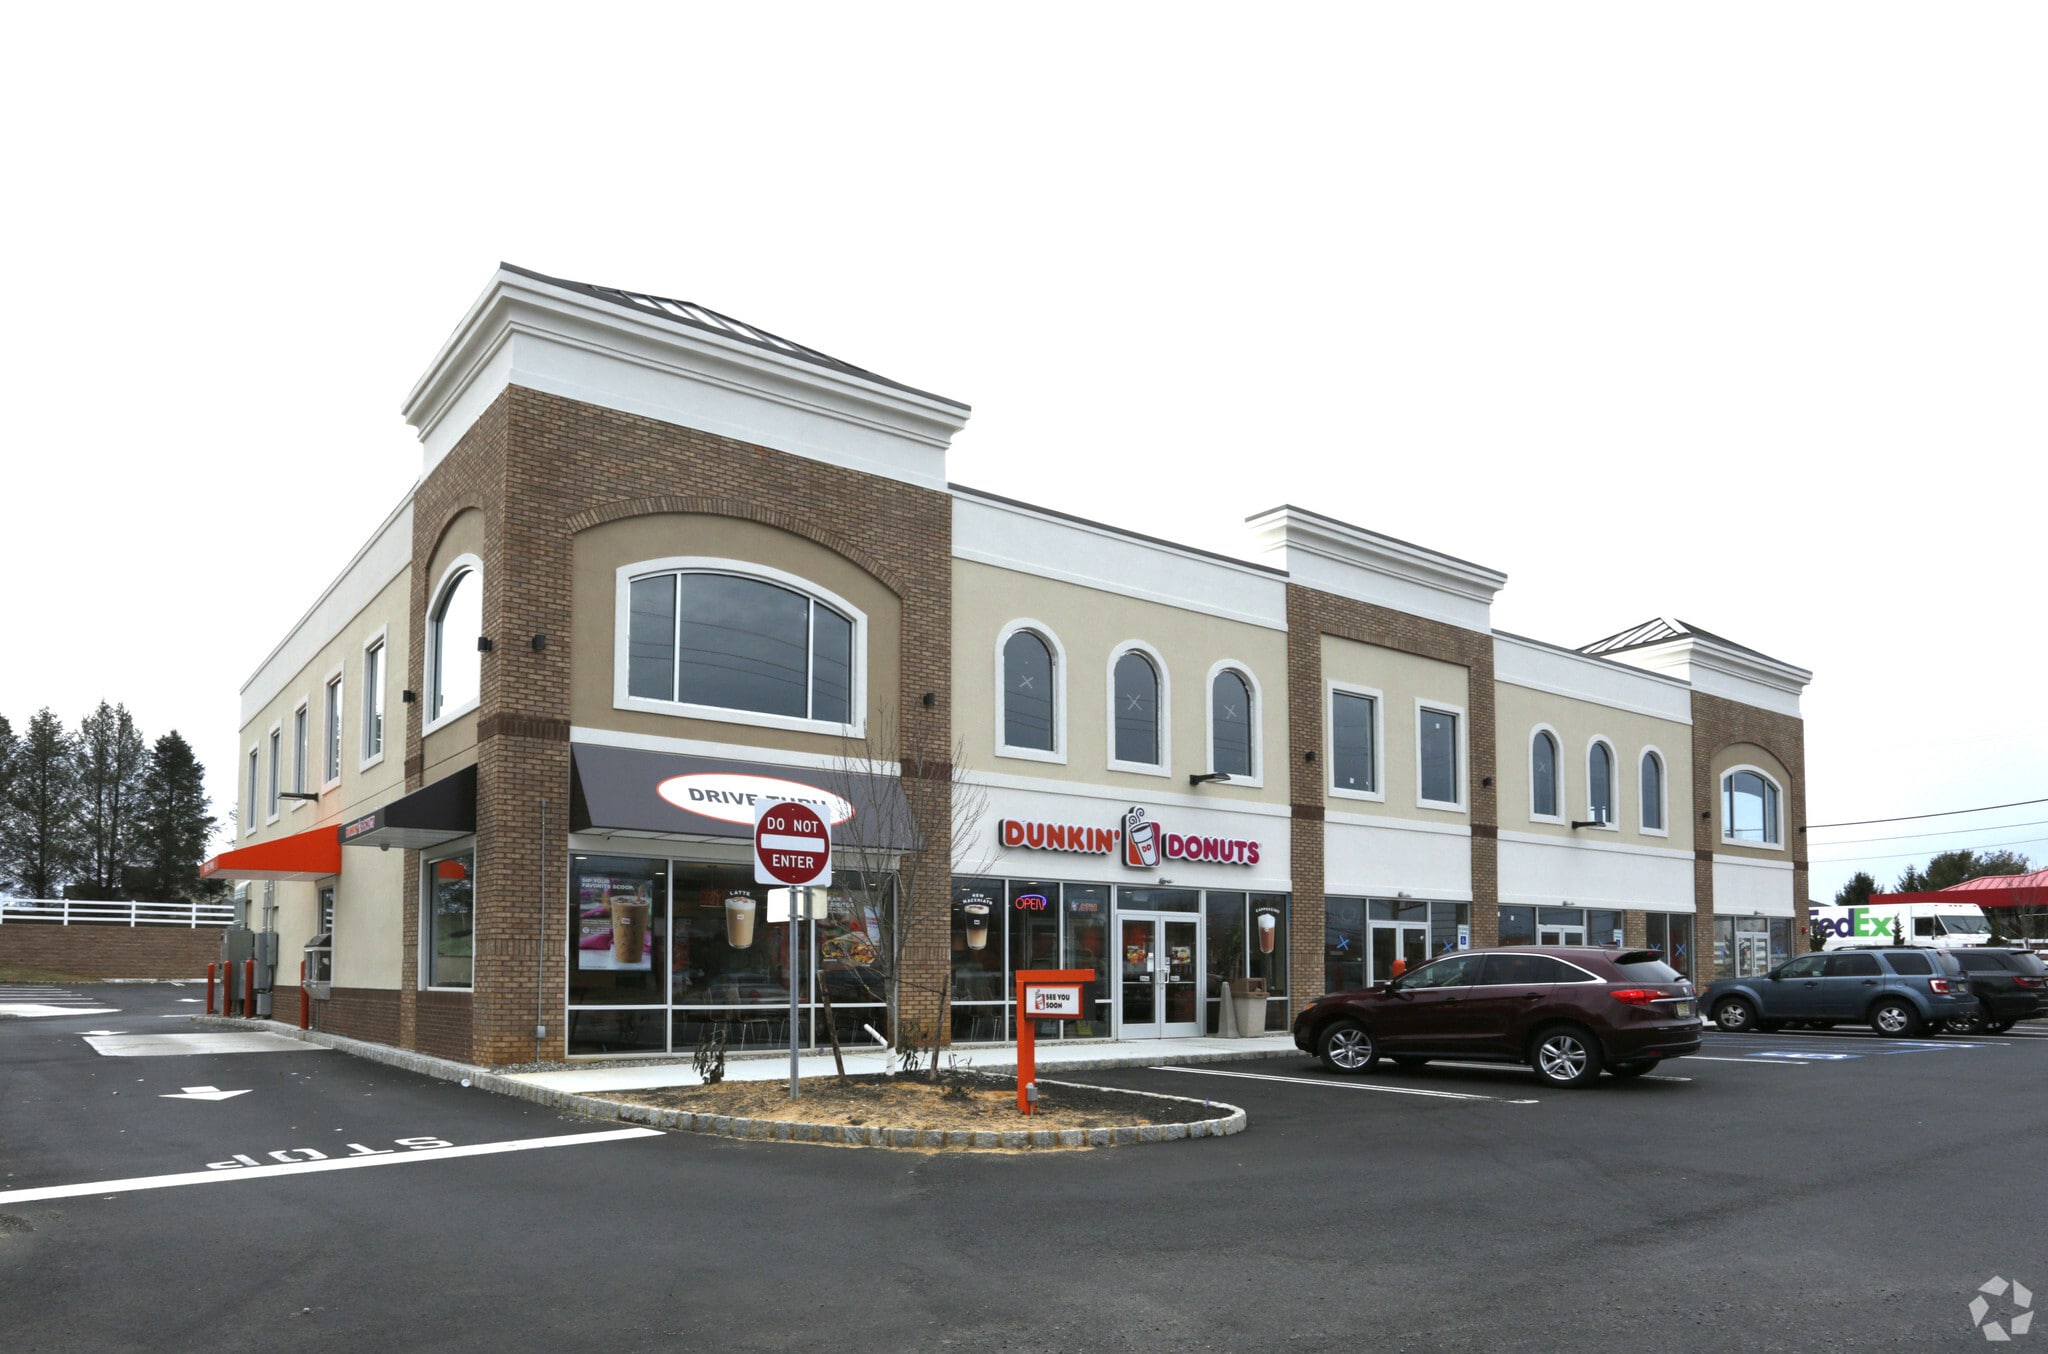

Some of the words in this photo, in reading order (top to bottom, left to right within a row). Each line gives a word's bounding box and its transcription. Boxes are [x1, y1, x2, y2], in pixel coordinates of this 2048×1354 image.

[688, 787, 758, 807] DRIVE
[767, 817, 785, 831] DO
[793, 819, 819, 833] NOT
[1005, 819, 1121, 853] DUNKIN'
[1168, 833, 1260, 865] DONUTS
[772, 854, 814, 869] ENTER
[1015, 897, 1045, 911] OPEN
[1045, 993, 1057, 1001] SEE
[1057, 993, 1070, 1001] YOU
[206, 1136, 454, 1170] STOP
